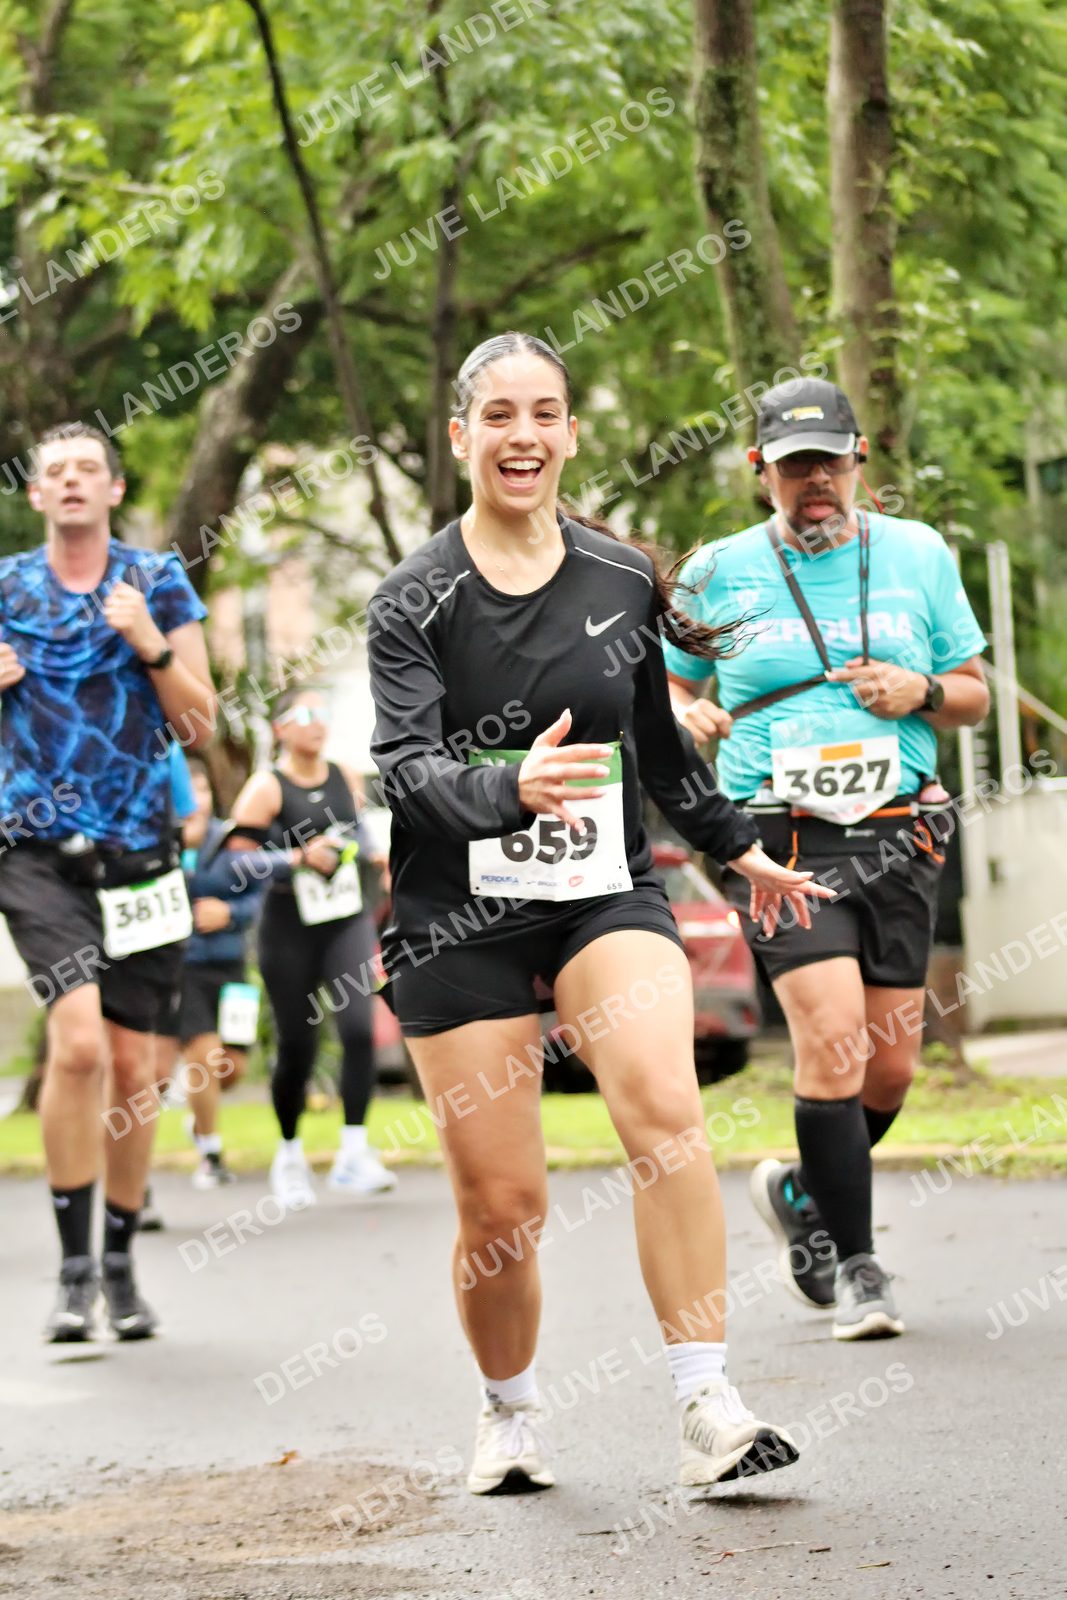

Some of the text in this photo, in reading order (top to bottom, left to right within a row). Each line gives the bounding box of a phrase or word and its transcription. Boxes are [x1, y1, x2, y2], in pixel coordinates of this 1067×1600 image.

[784, 758, 891, 799] 3627
[501, 816, 598, 864] 659
[114, 887, 183, 929] 3815
